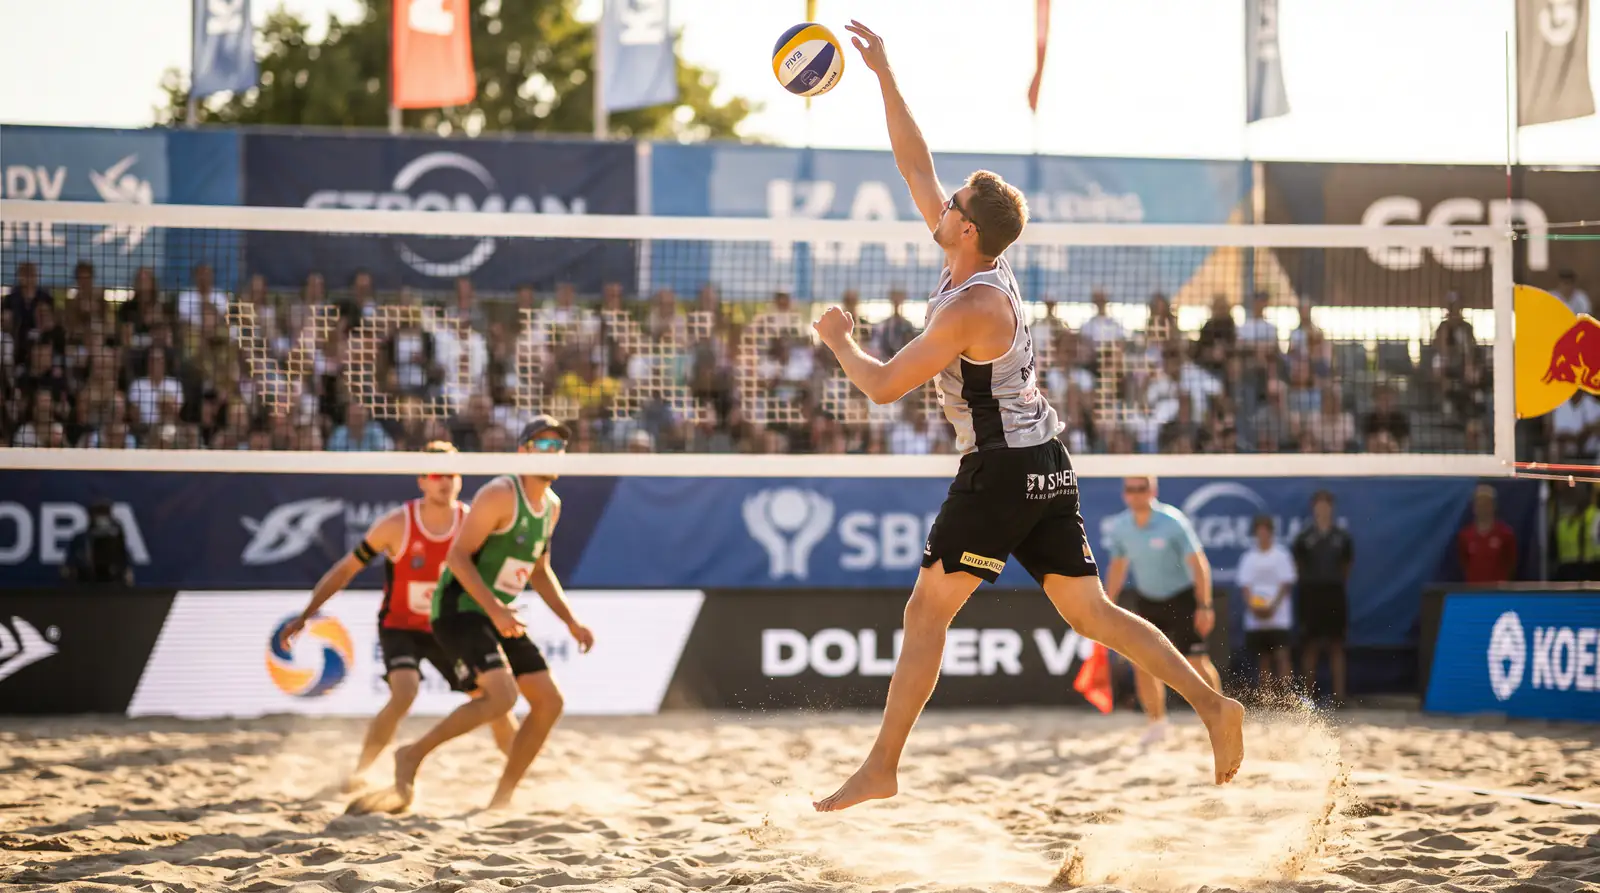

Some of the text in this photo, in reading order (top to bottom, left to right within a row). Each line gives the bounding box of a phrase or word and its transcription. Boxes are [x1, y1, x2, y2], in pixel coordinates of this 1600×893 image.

[0, 165, 67, 200] DV
[761, 628, 1092, 676] DOLER V
[1532, 626, 1600, 691] KOE
